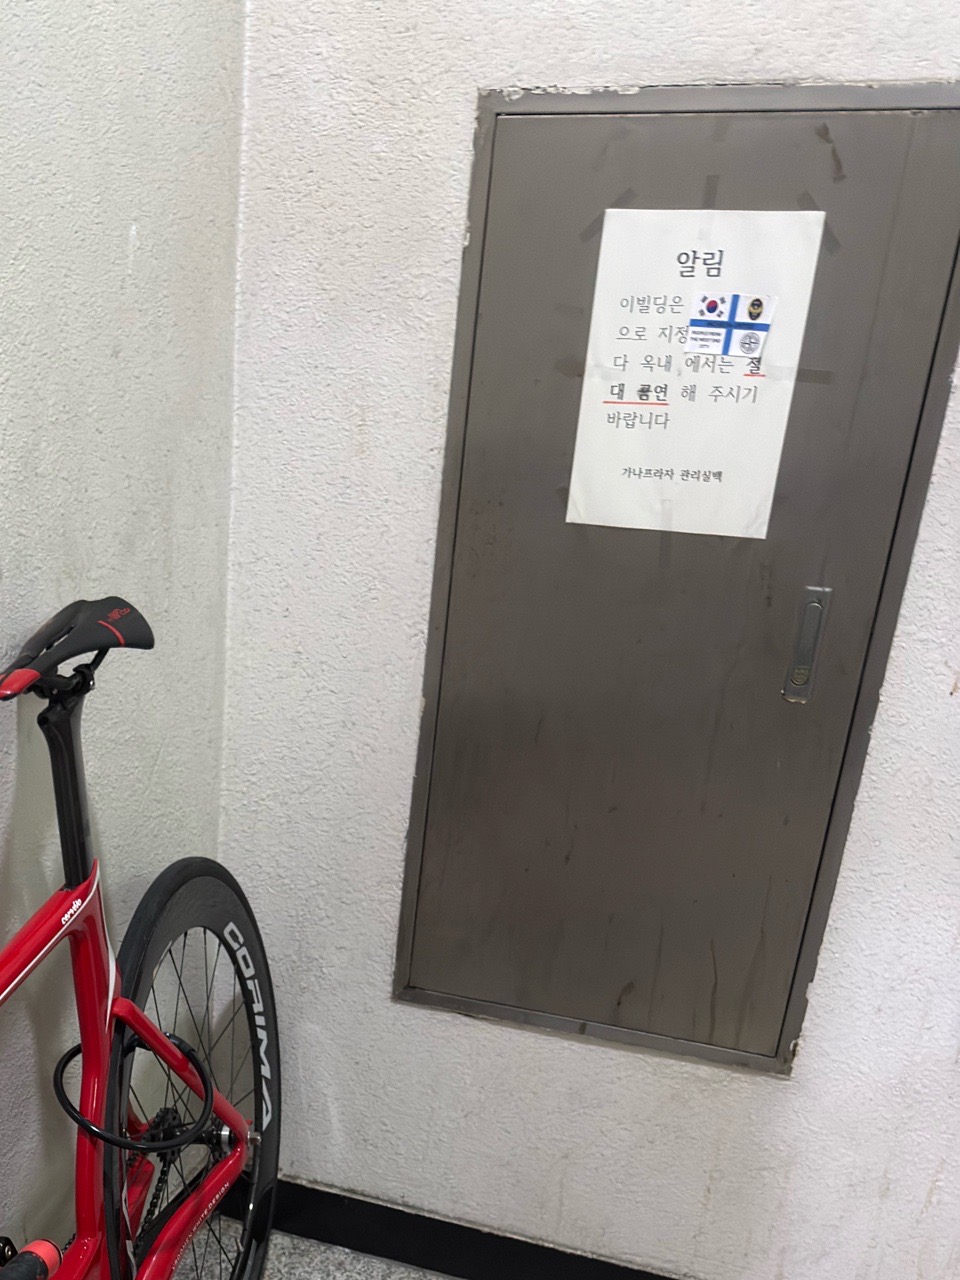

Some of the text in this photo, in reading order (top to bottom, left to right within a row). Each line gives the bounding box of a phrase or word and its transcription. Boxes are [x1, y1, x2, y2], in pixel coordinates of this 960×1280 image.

[677, 249, 724, 278] 알림
[620, 294, 684, 314] 이빌딩은
[616, 325, 647, 341] 으로
[613, 354, 629, 371] 다
[640, 354, 672, 373] 옥내
[685, 355, 734, 374] 에서는
[610, 383, 625, 400] 대
[681, 384, 696, 401] 해
[709, 385, 757, 403] 주시기
[607, 411, 670, 429] 바랍니다
[223, 921, 272, 1131] CORIMA
